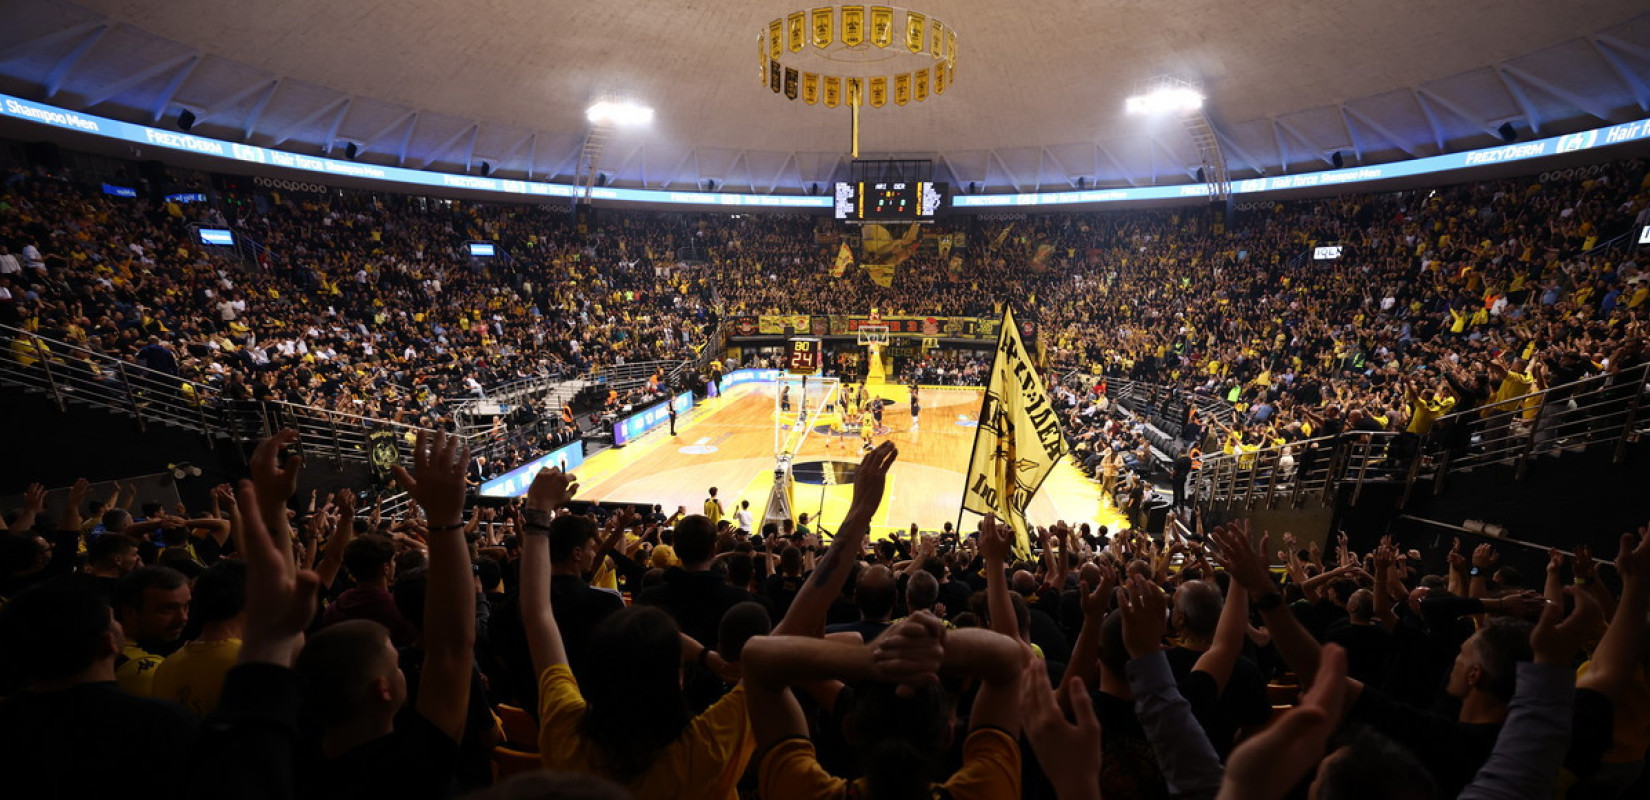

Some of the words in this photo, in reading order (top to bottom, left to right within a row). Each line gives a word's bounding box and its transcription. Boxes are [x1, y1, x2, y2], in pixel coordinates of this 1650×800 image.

[6, 99, 65, 124] Shampoo
[67, 115, 99, 131] Men
[1606, 123, 1640, 144] Hair
[271, 150, 294, 167] Hair
[1465, 142, 1545, 165] FREZYDERM
[791, 352, 813, 367] 24
